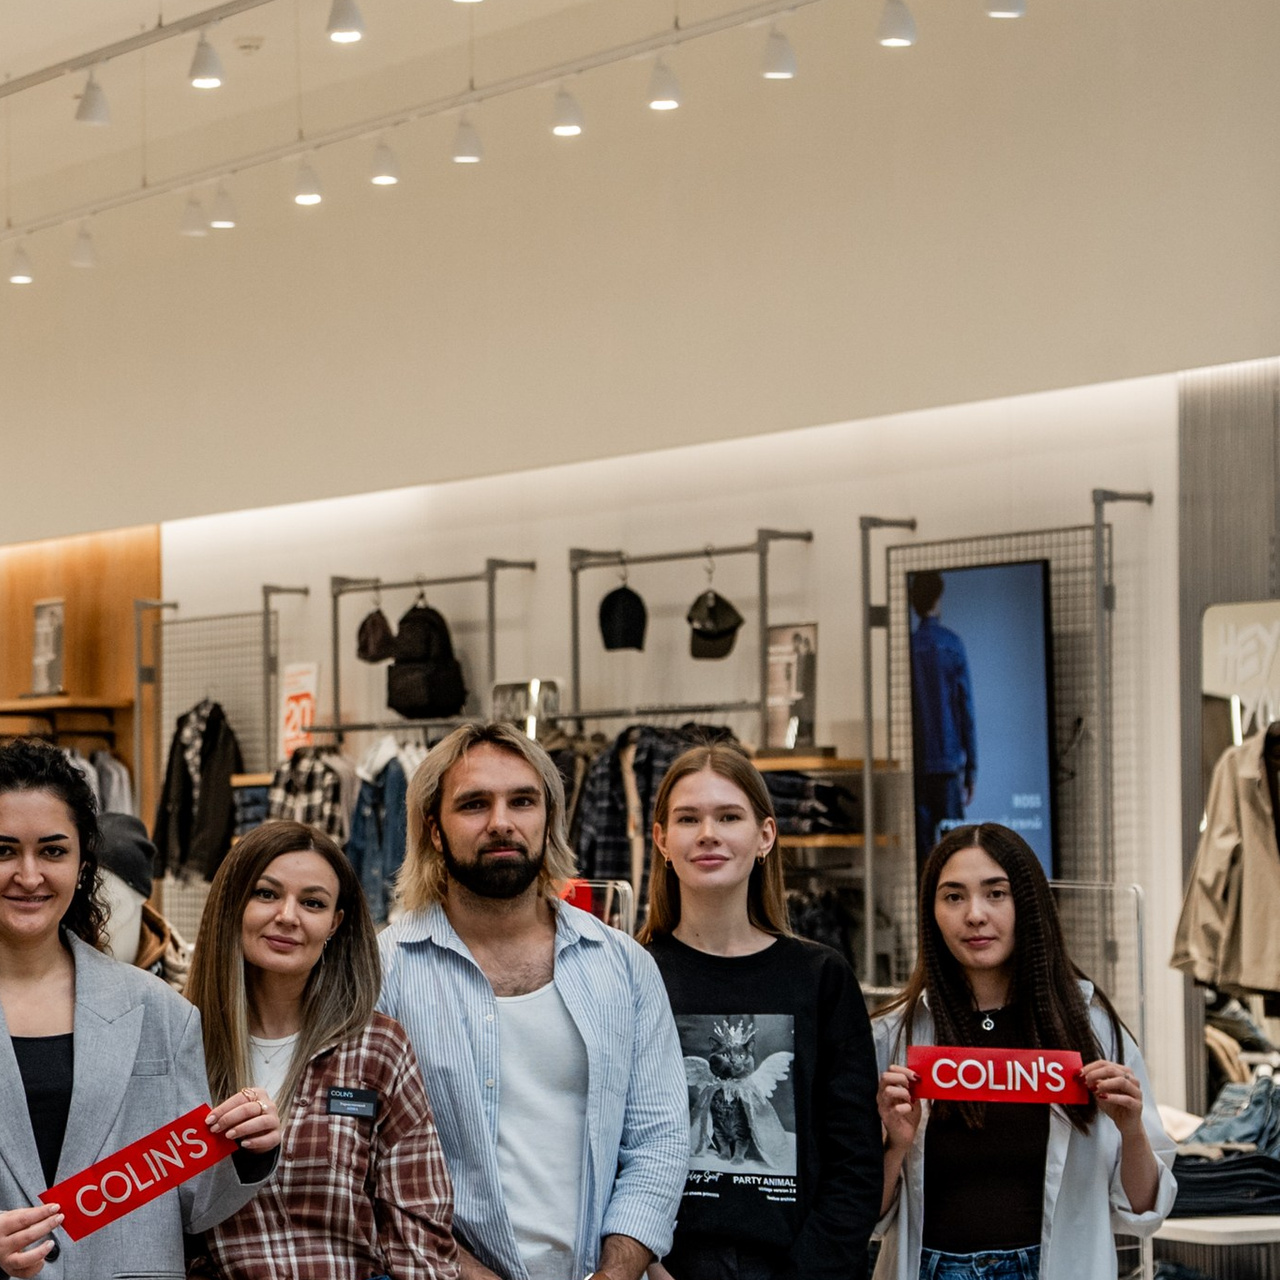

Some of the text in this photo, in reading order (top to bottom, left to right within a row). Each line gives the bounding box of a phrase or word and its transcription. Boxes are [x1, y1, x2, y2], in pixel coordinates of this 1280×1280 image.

[931, 1057, 1066, 1092] COLIN'S
[331, 1090, 353, 1098] COLIN'S
[76, 1128, 208, 1217] COLIN'S
[733, 1176, 797, 1187] PARTY ANIMAL
